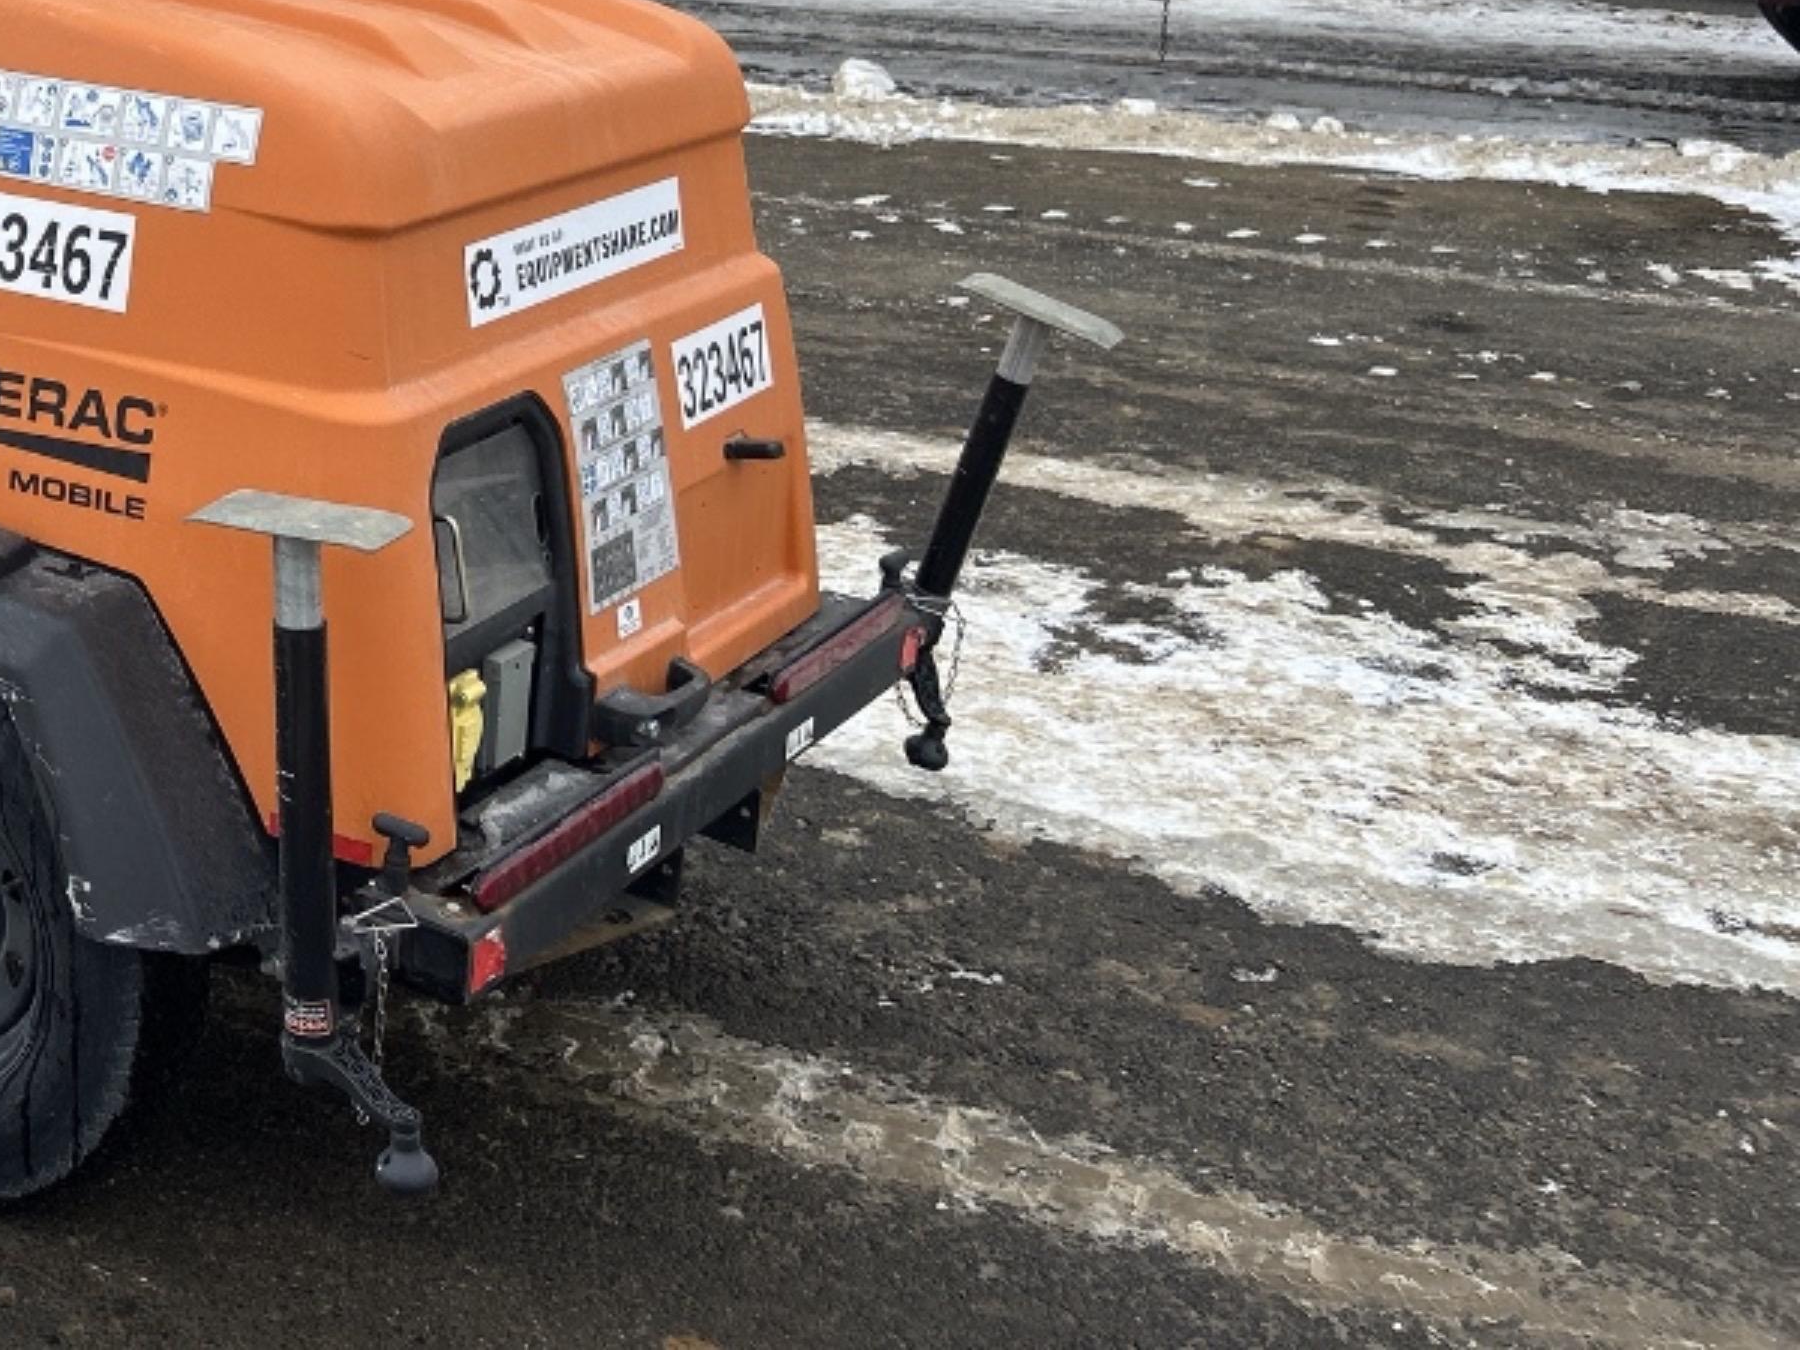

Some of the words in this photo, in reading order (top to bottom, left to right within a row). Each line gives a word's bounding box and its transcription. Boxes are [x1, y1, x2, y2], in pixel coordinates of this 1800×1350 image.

[515, 209, 679, 291] EQUIPMENTSHARE.COM
[678, 320, 765, 418] 323467
[8, 470, 147, 520] MOBILE
